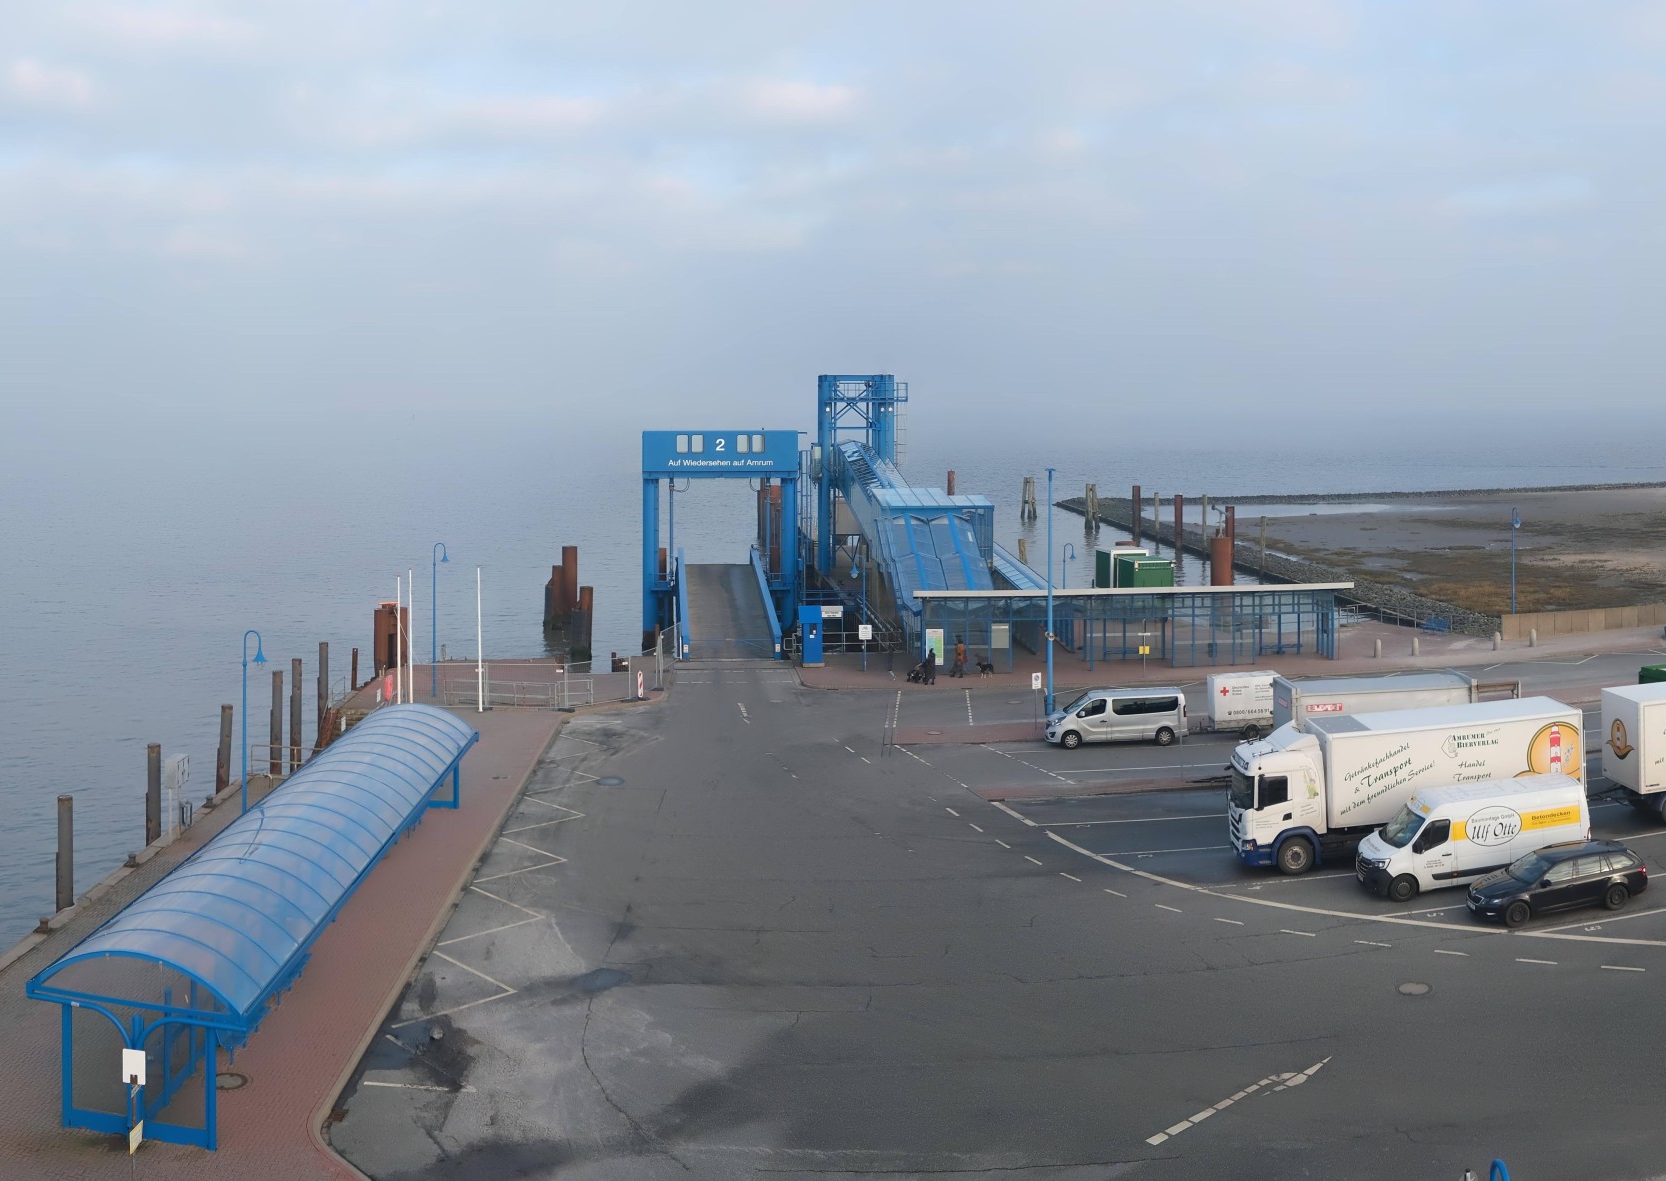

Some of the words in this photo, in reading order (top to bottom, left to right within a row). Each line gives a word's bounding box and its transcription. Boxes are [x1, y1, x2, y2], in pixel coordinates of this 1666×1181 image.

[715, 438, 726, 451] 2
[668, 459, 681, 467] Auf
[683, 459, 731, 467] Wiedersehen
[732, 459, 745, 467] auf
[747, 459, 774, 467] Amrum
[1457, 739, 1499, 748] BIERVERLAG
[1344, 742, 1410, 782] Getränkefachhandel
[1458, 759, 1485, 768] Handel
[1654, 756, 1665, 765] mit
[1354, 786, 1360, 794] &
[1360, 757, 1412, 788] Transport
[1453, 771, 1492, 782] Transport
[1340, 806, 1352, 816] mit
[1352, 800, 1366, 810] dem
[1367, 777, 1407, 804] freundlichen
[1407, 760, 1435, 782] Service!
[1531, 810, 1571, 821] Betondecken
[1472, 823, 1491, 842] Ulf
[1493, 821, 1517, 837] Otte
